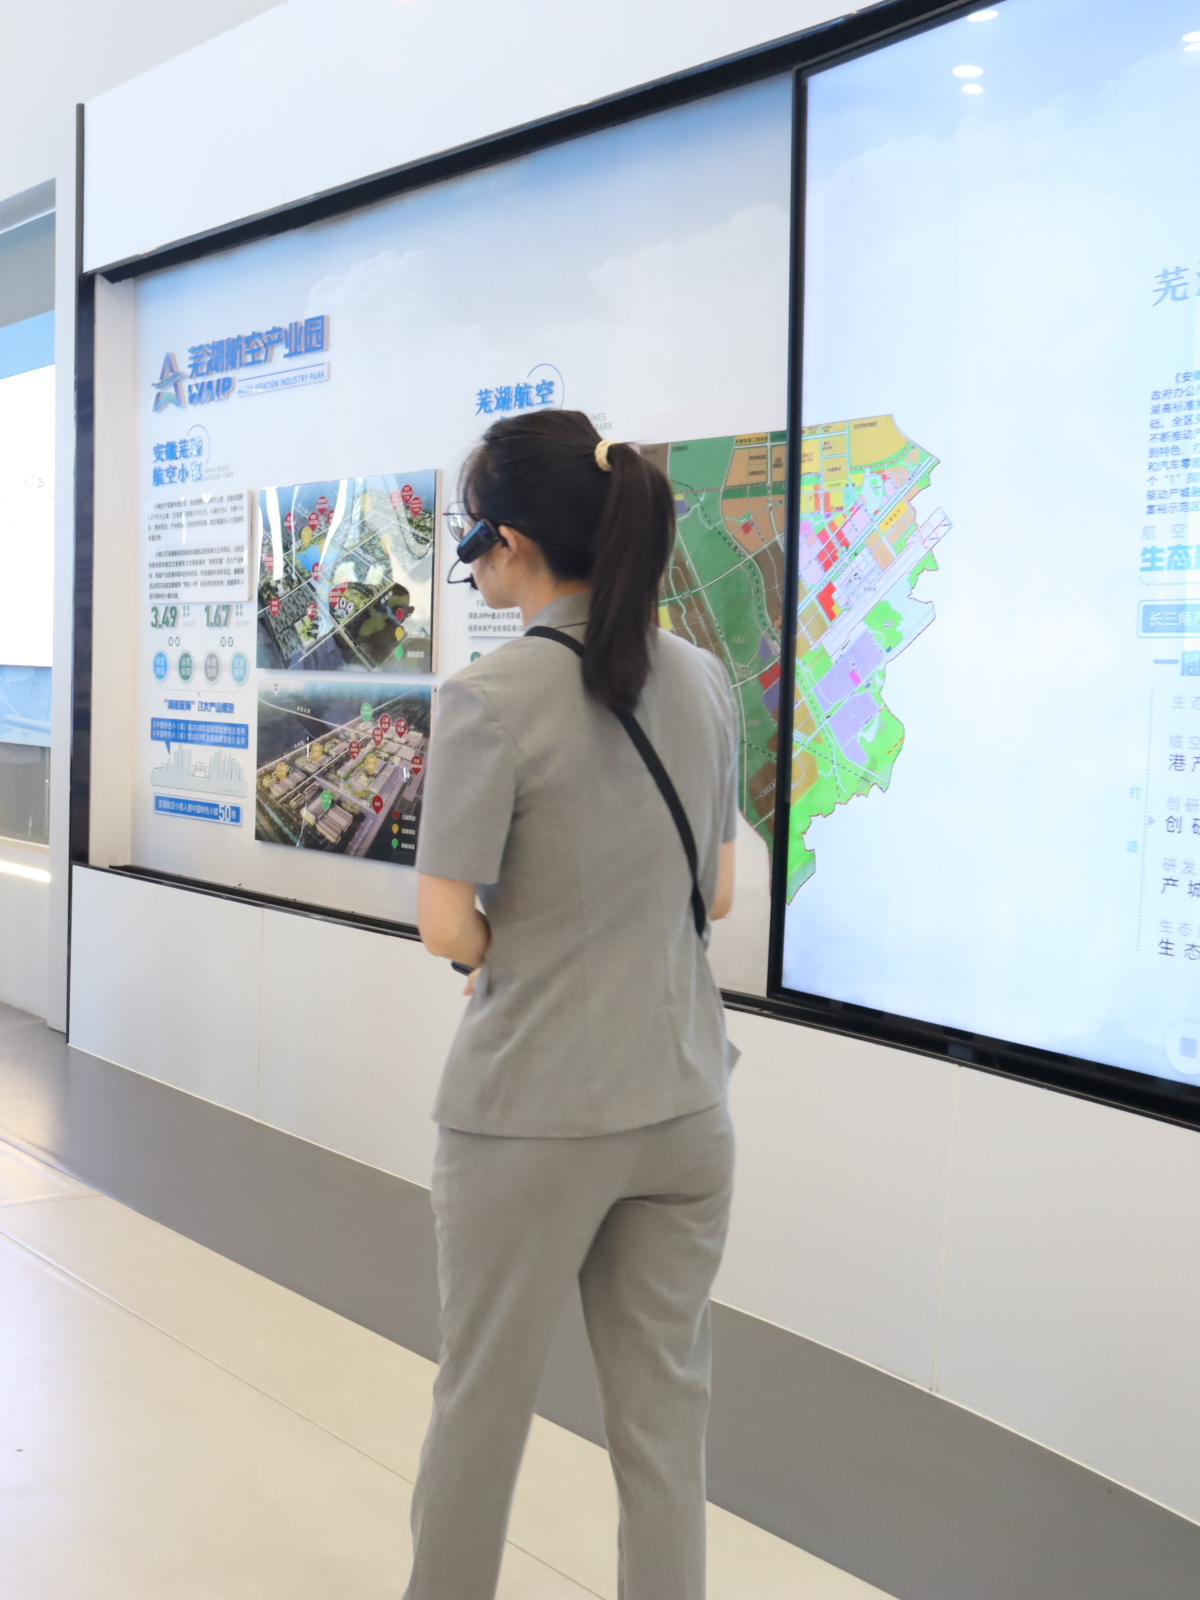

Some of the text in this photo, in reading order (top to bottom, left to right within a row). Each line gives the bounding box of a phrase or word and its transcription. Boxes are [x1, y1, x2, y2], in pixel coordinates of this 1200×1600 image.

[1152, 264, 1200, 307] 芜
[188, 315, 328, 378] 芜湖航空产业园
[255, 380, 279, 390] AVIATION
[280, 374, 308, 387] INDUSTRY
[310, 371, 326, 381] PARK
[474, 379, 555, 416] 芜湖航空
[1139, 544, 1200, 572] 生态
[151, 605, 179, 628] 3.49
[204, 603, 232, 628] 1.67
[1158, 918, 1200, 939] 生态
